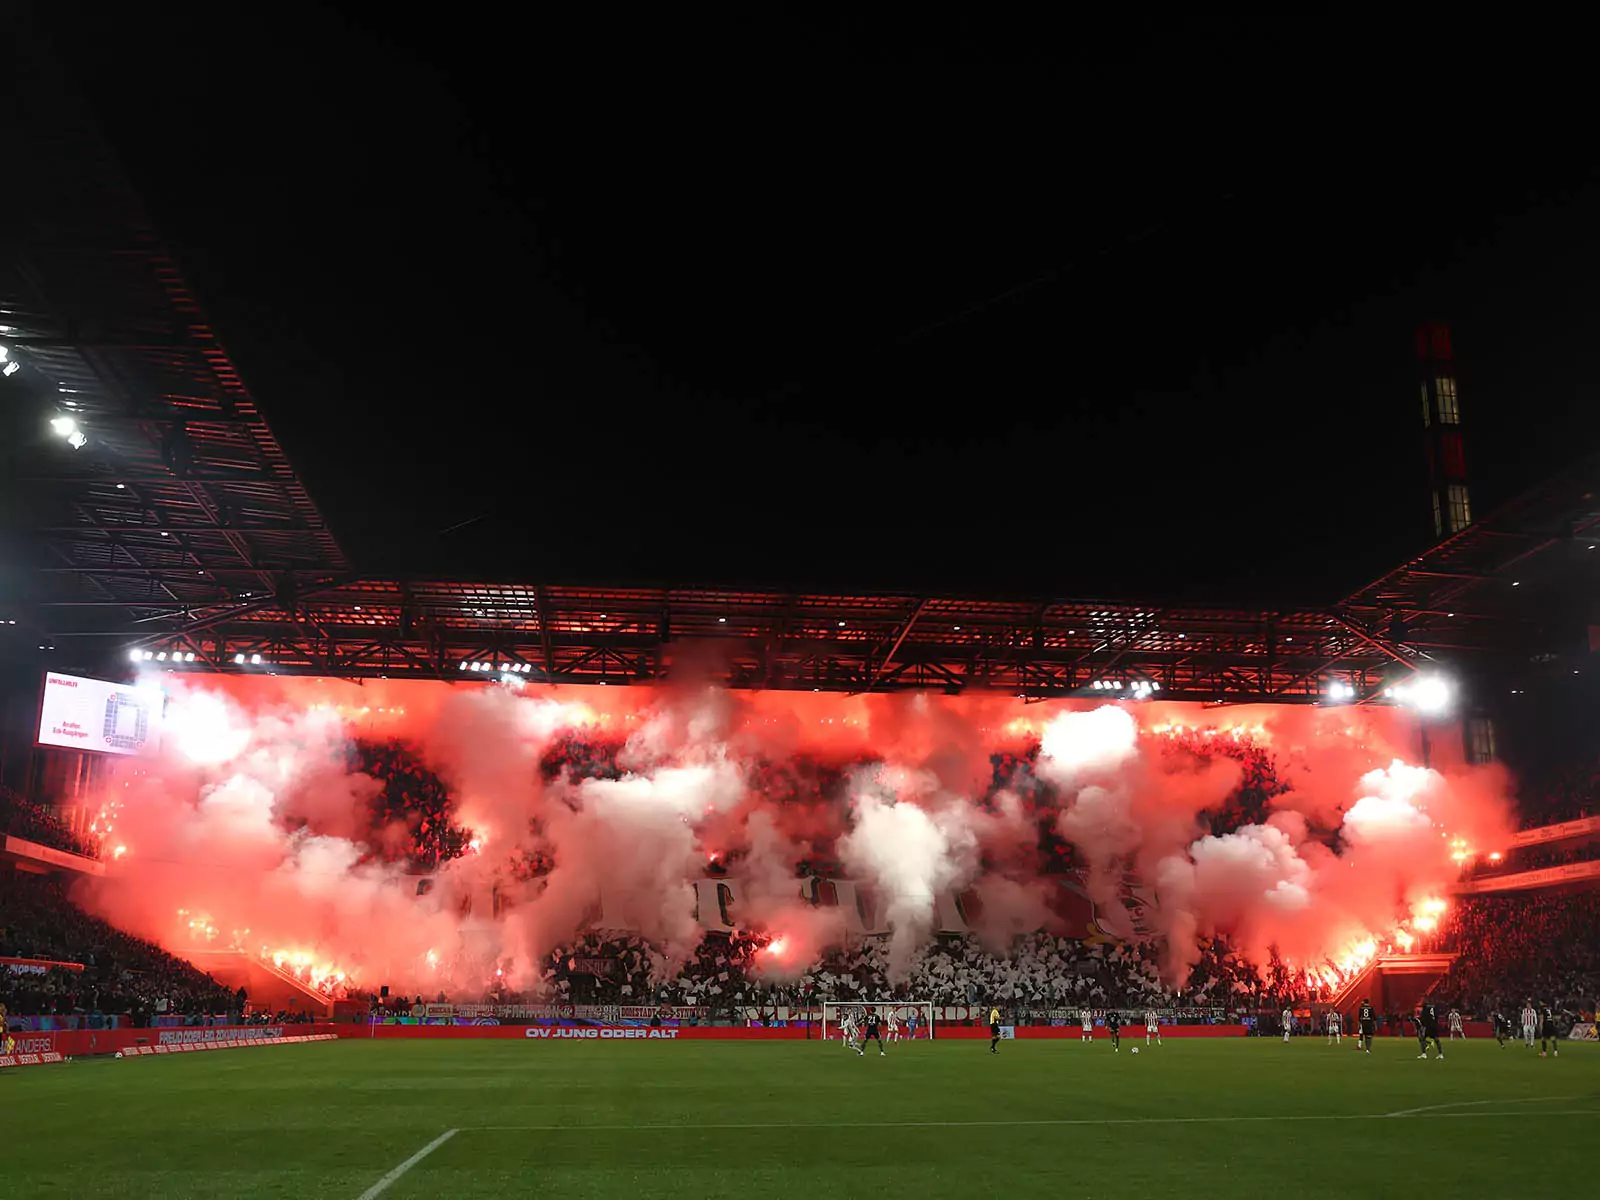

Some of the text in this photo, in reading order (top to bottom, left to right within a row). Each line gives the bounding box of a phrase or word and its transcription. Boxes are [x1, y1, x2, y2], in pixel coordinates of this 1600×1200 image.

[1363, 1008, 1369, 1018] 8
[868, 1014, 877, 1024] 21
[525, 1028, 679, 1038] OV JUNG ODER ALT
